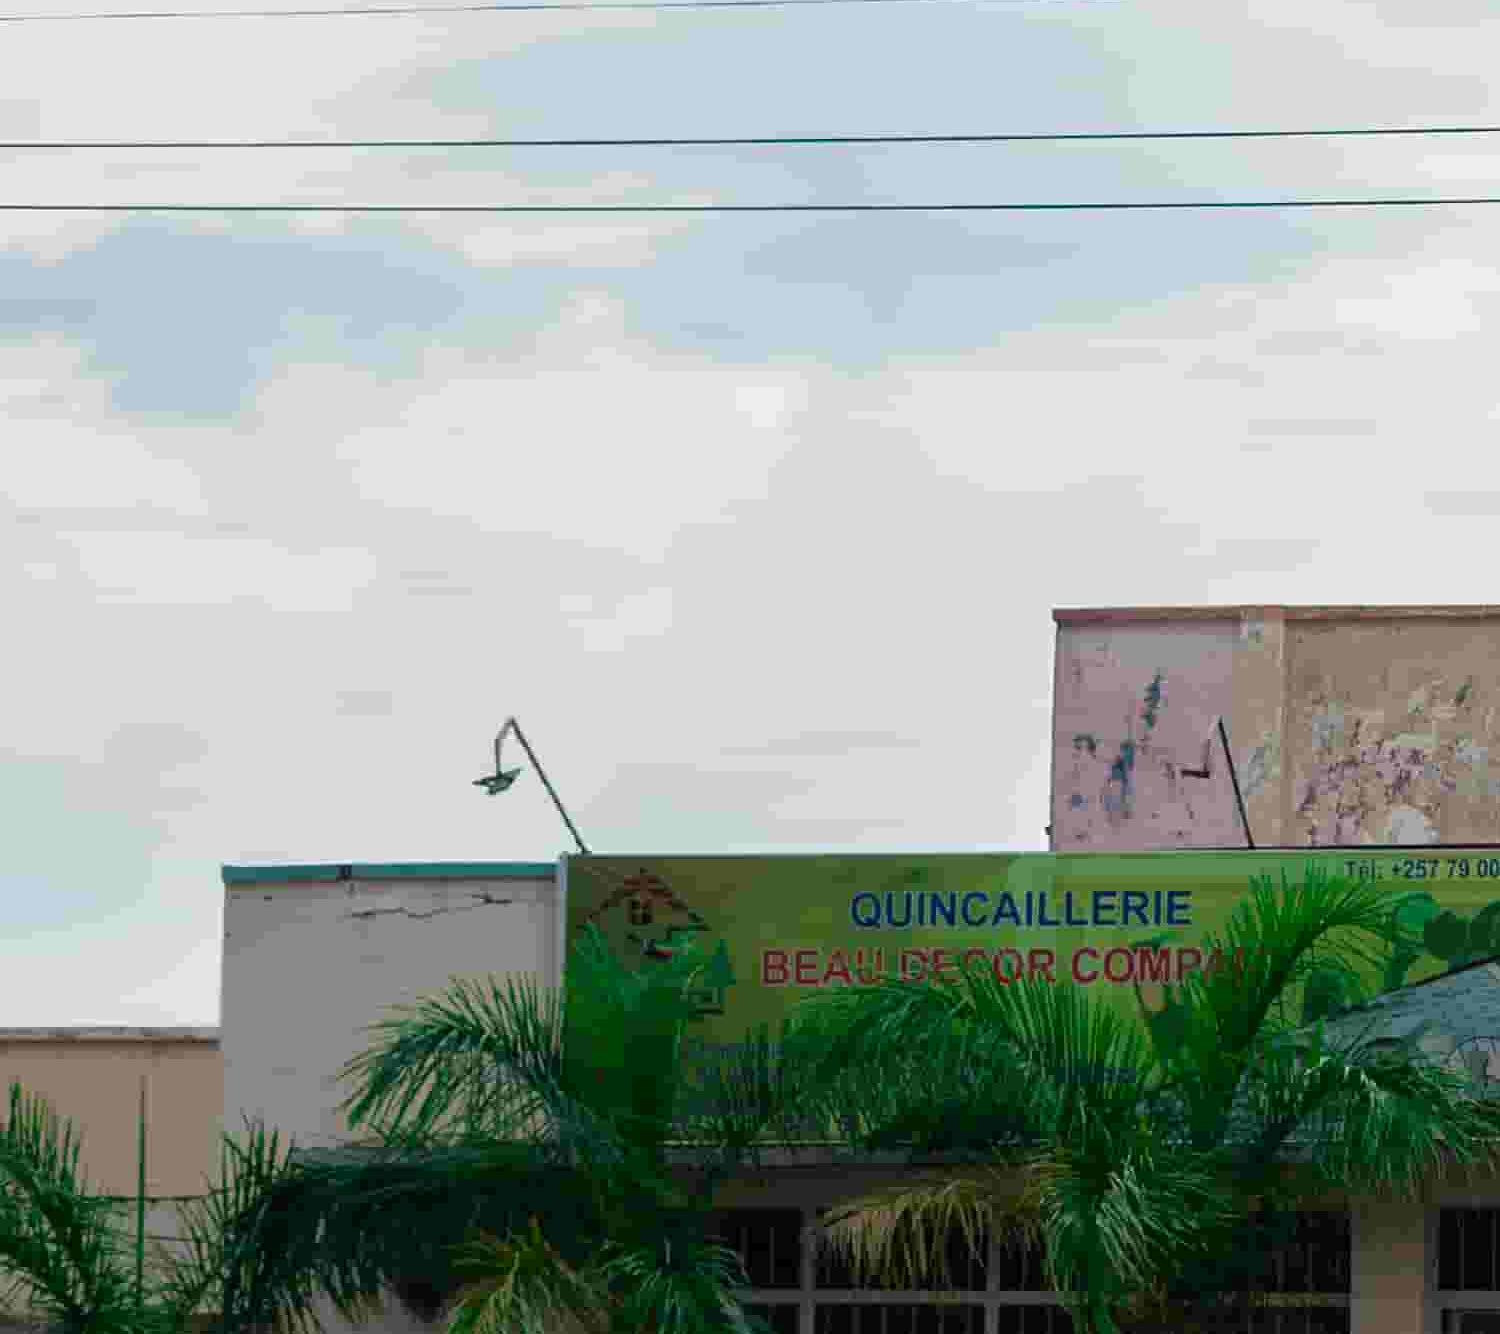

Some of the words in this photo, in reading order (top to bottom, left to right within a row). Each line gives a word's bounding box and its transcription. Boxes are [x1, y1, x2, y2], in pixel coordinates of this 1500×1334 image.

[1391, 860, 1438, 879] +257
[1447, 860, 1468, 878] 79
[851, 890, 1192, 929] QUINCAILLERIE
[762, 948, 886, 987] BEAU
[898, 947, 1056, 986] DECOR
